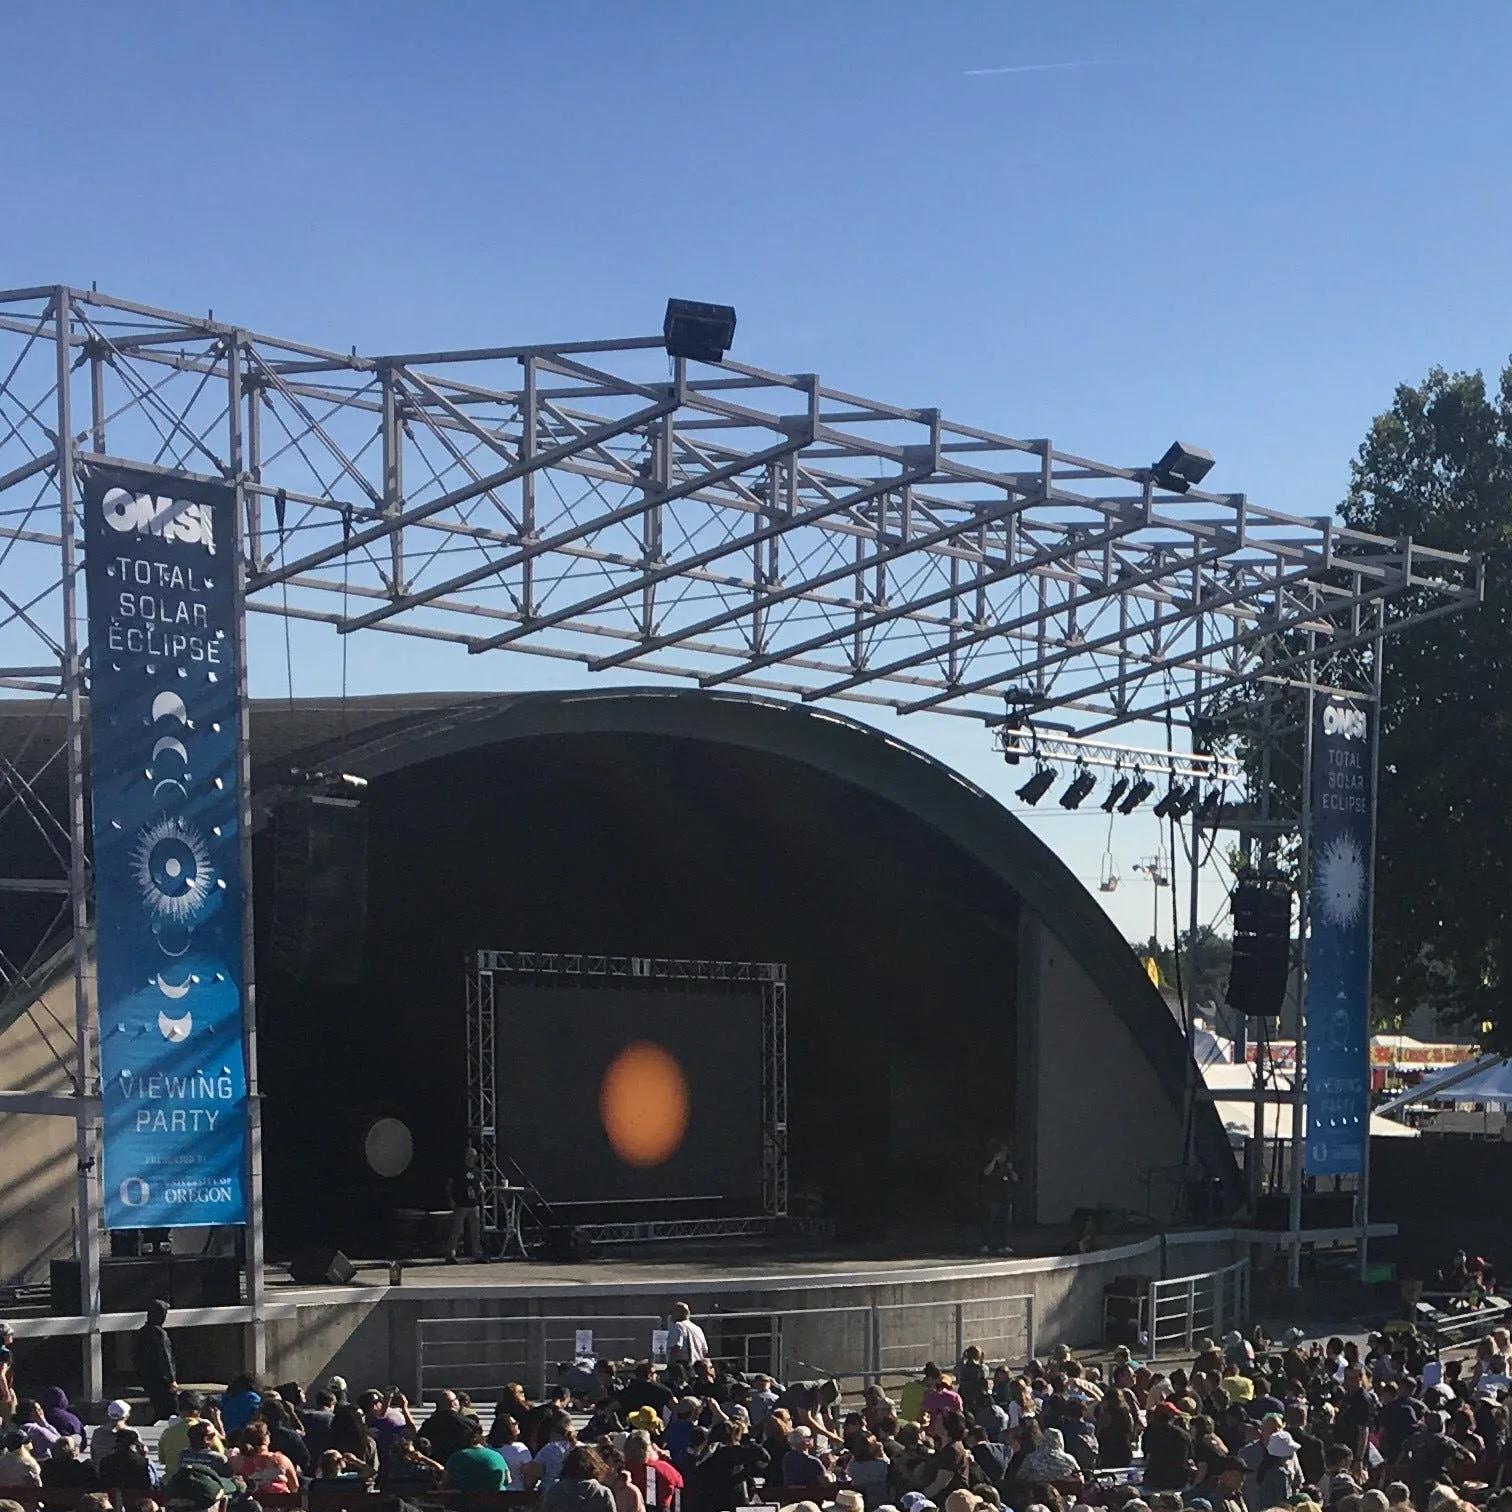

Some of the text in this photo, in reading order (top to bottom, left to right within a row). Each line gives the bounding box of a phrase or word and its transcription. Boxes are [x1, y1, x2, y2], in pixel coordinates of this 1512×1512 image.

[102, 487, 216, 545] OMSI
[116, 557, 200, 592] TOTAL
[119, 593, 208, 628] SOLAR
[109, 626, 221, 664] ECLIPSE
[1328, 750, 1362, 769] TOTAL
[1328, 772, 1364, 791] SOLAR
[1322, 793, 1367, 814] ECLIPSE
[119, 1076, 233, 1099] VIEWING
[136, 1109, 219, 1132] PARTY
[164, 1186, 233, 1204] OREGON
